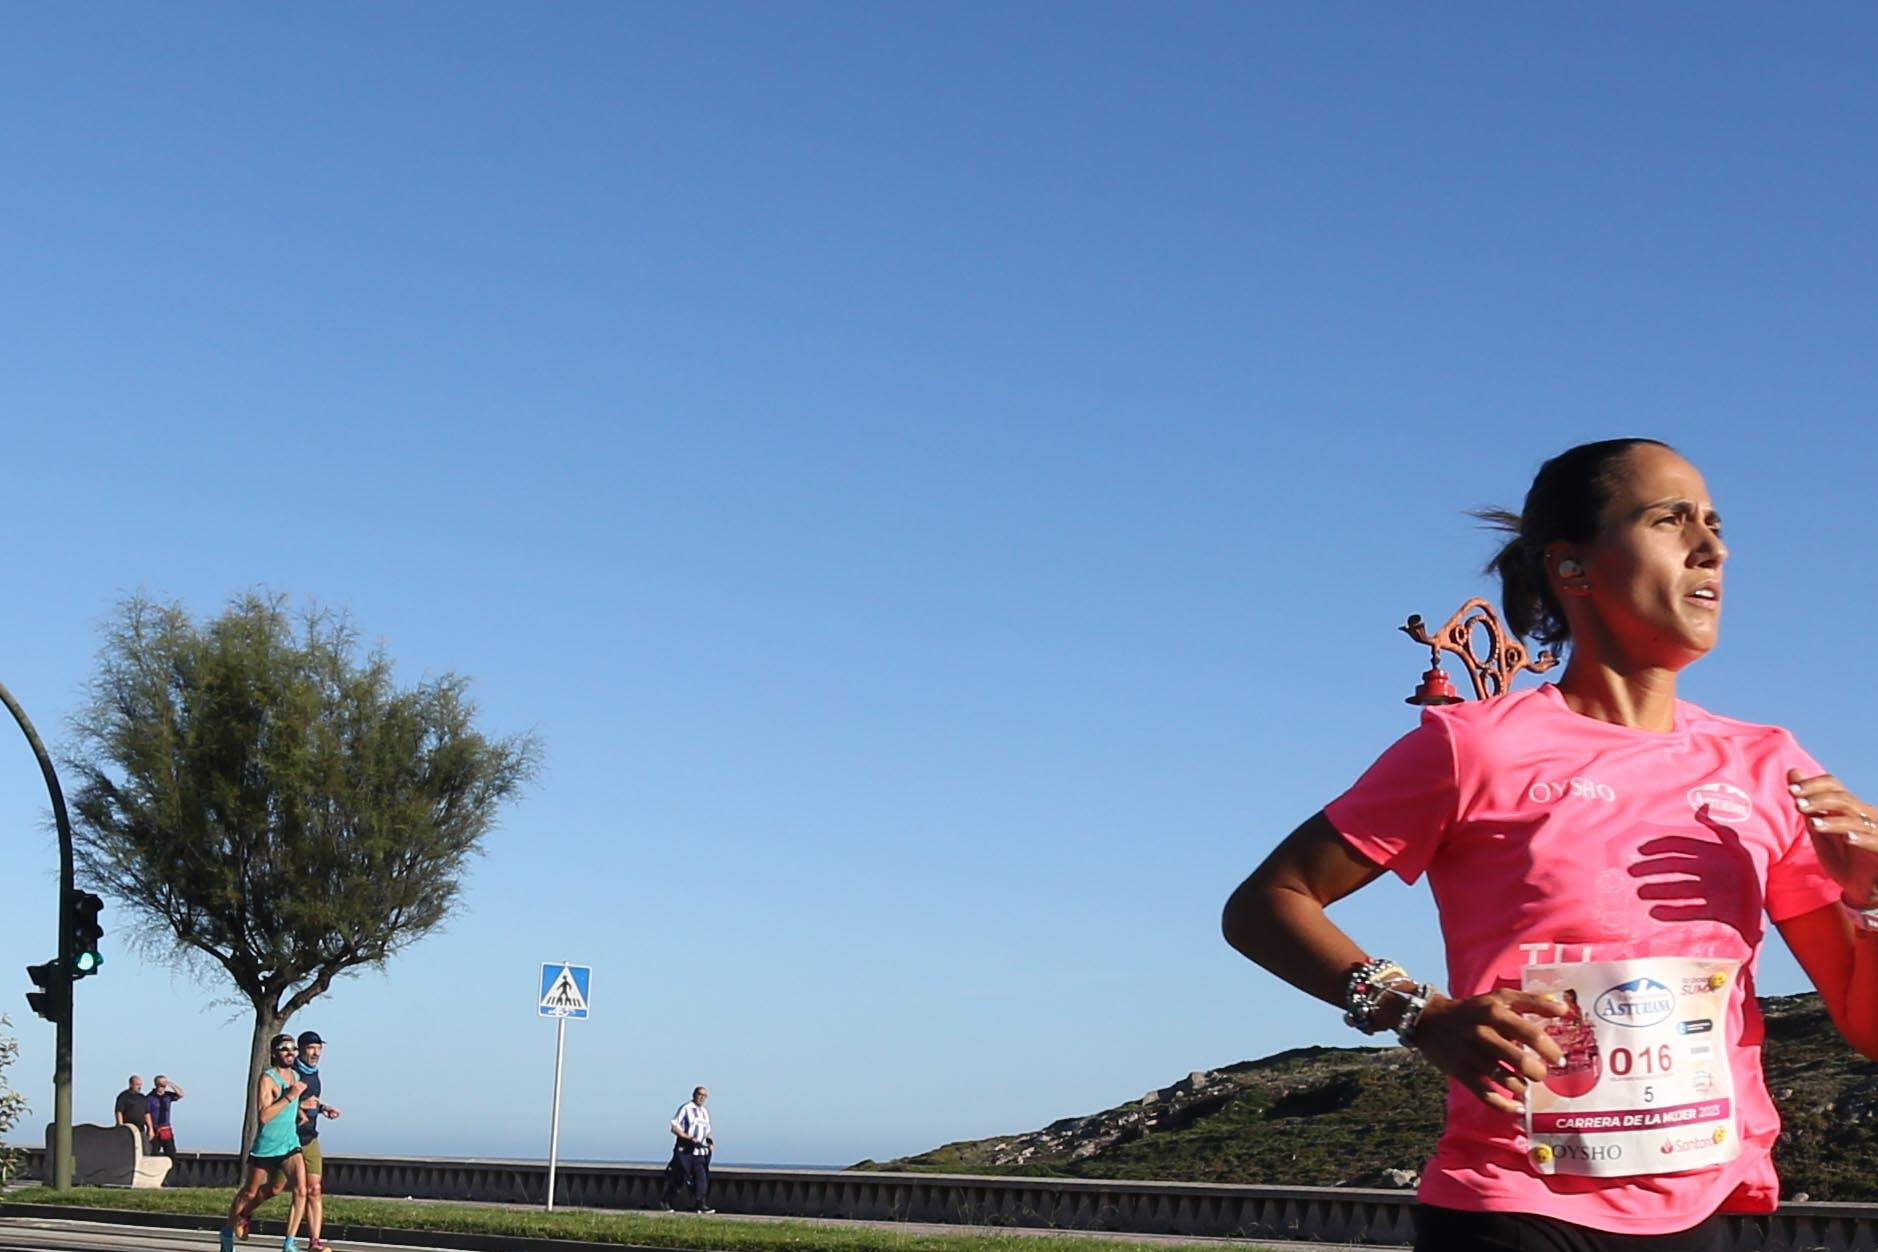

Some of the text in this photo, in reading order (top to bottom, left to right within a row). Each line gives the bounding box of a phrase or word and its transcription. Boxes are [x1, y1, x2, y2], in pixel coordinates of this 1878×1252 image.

[1528, 776, 1616, 803] OYSHO
[1599, 997, 1671, 1016] ASTURIANA
[1643, 1086, 1654, 1103] 5
[1555, 1116, 1621, 1129] CARRERA
[1623, 1115, 1643, 1127] DE
[1644, 1113, 1662, 1125] LA
[1662, 1109, 1697, 1123] MUJER
[1551, 1144, 1622, 1161] OYSHO
